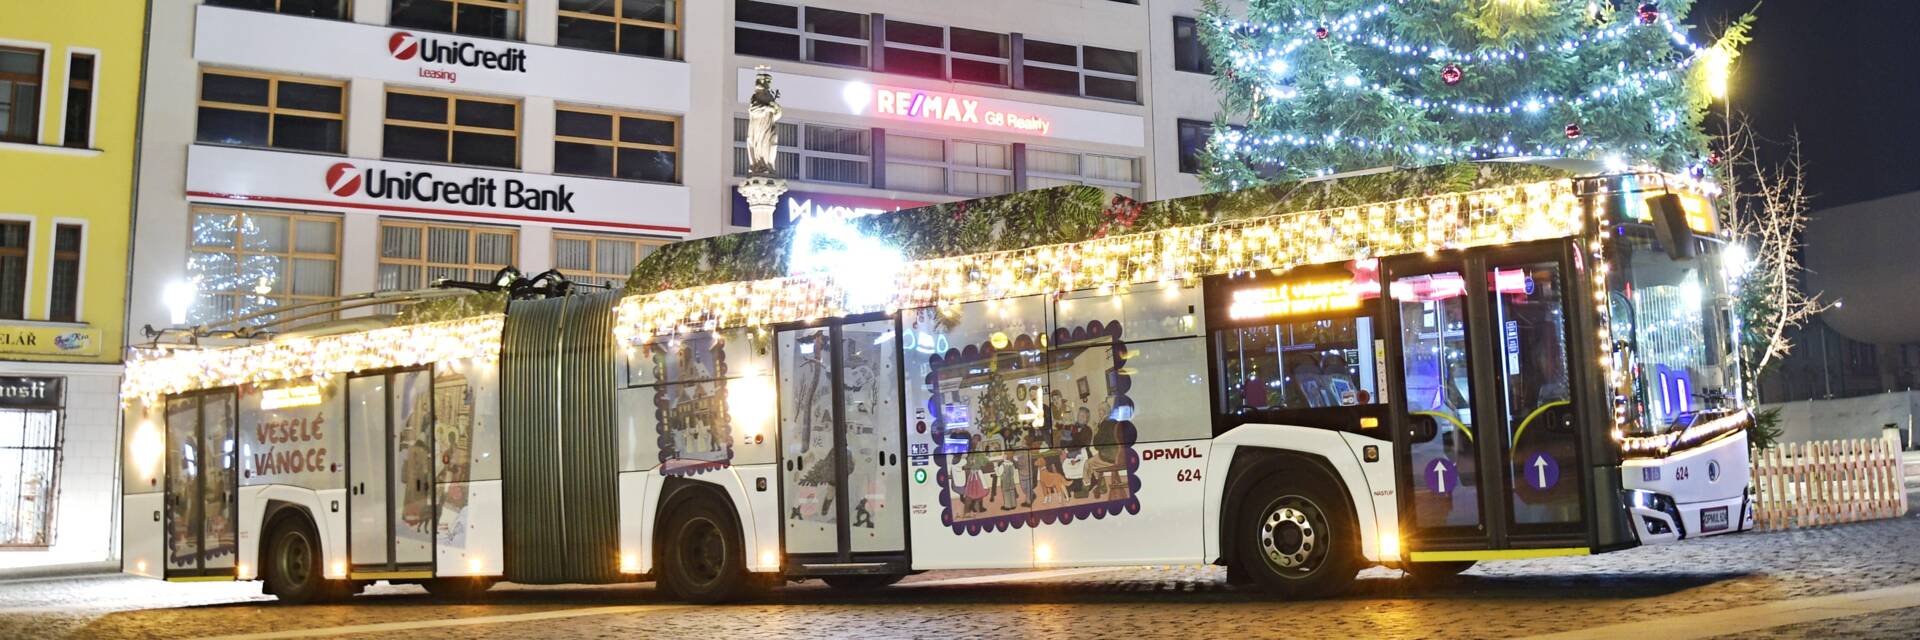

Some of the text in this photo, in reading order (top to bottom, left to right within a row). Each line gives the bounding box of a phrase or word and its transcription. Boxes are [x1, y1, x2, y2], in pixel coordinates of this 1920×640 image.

[420, 37, 527, 73] UniCredit
[419, 66, 457, 83] Leasing
[877, 89, 1050, 135] RE/MAX G8 Reality
[365, 167, 575, 213] UniCredit Bank
[256, 411, 325, 445] VESELÉ
[254, 445, 327, 477] VÁNOCE
[1142, 444, 1203, 461] DPMÚL
[1176, 468, 1202, 482] 624
[1675, 466, 1689, 481] 624
